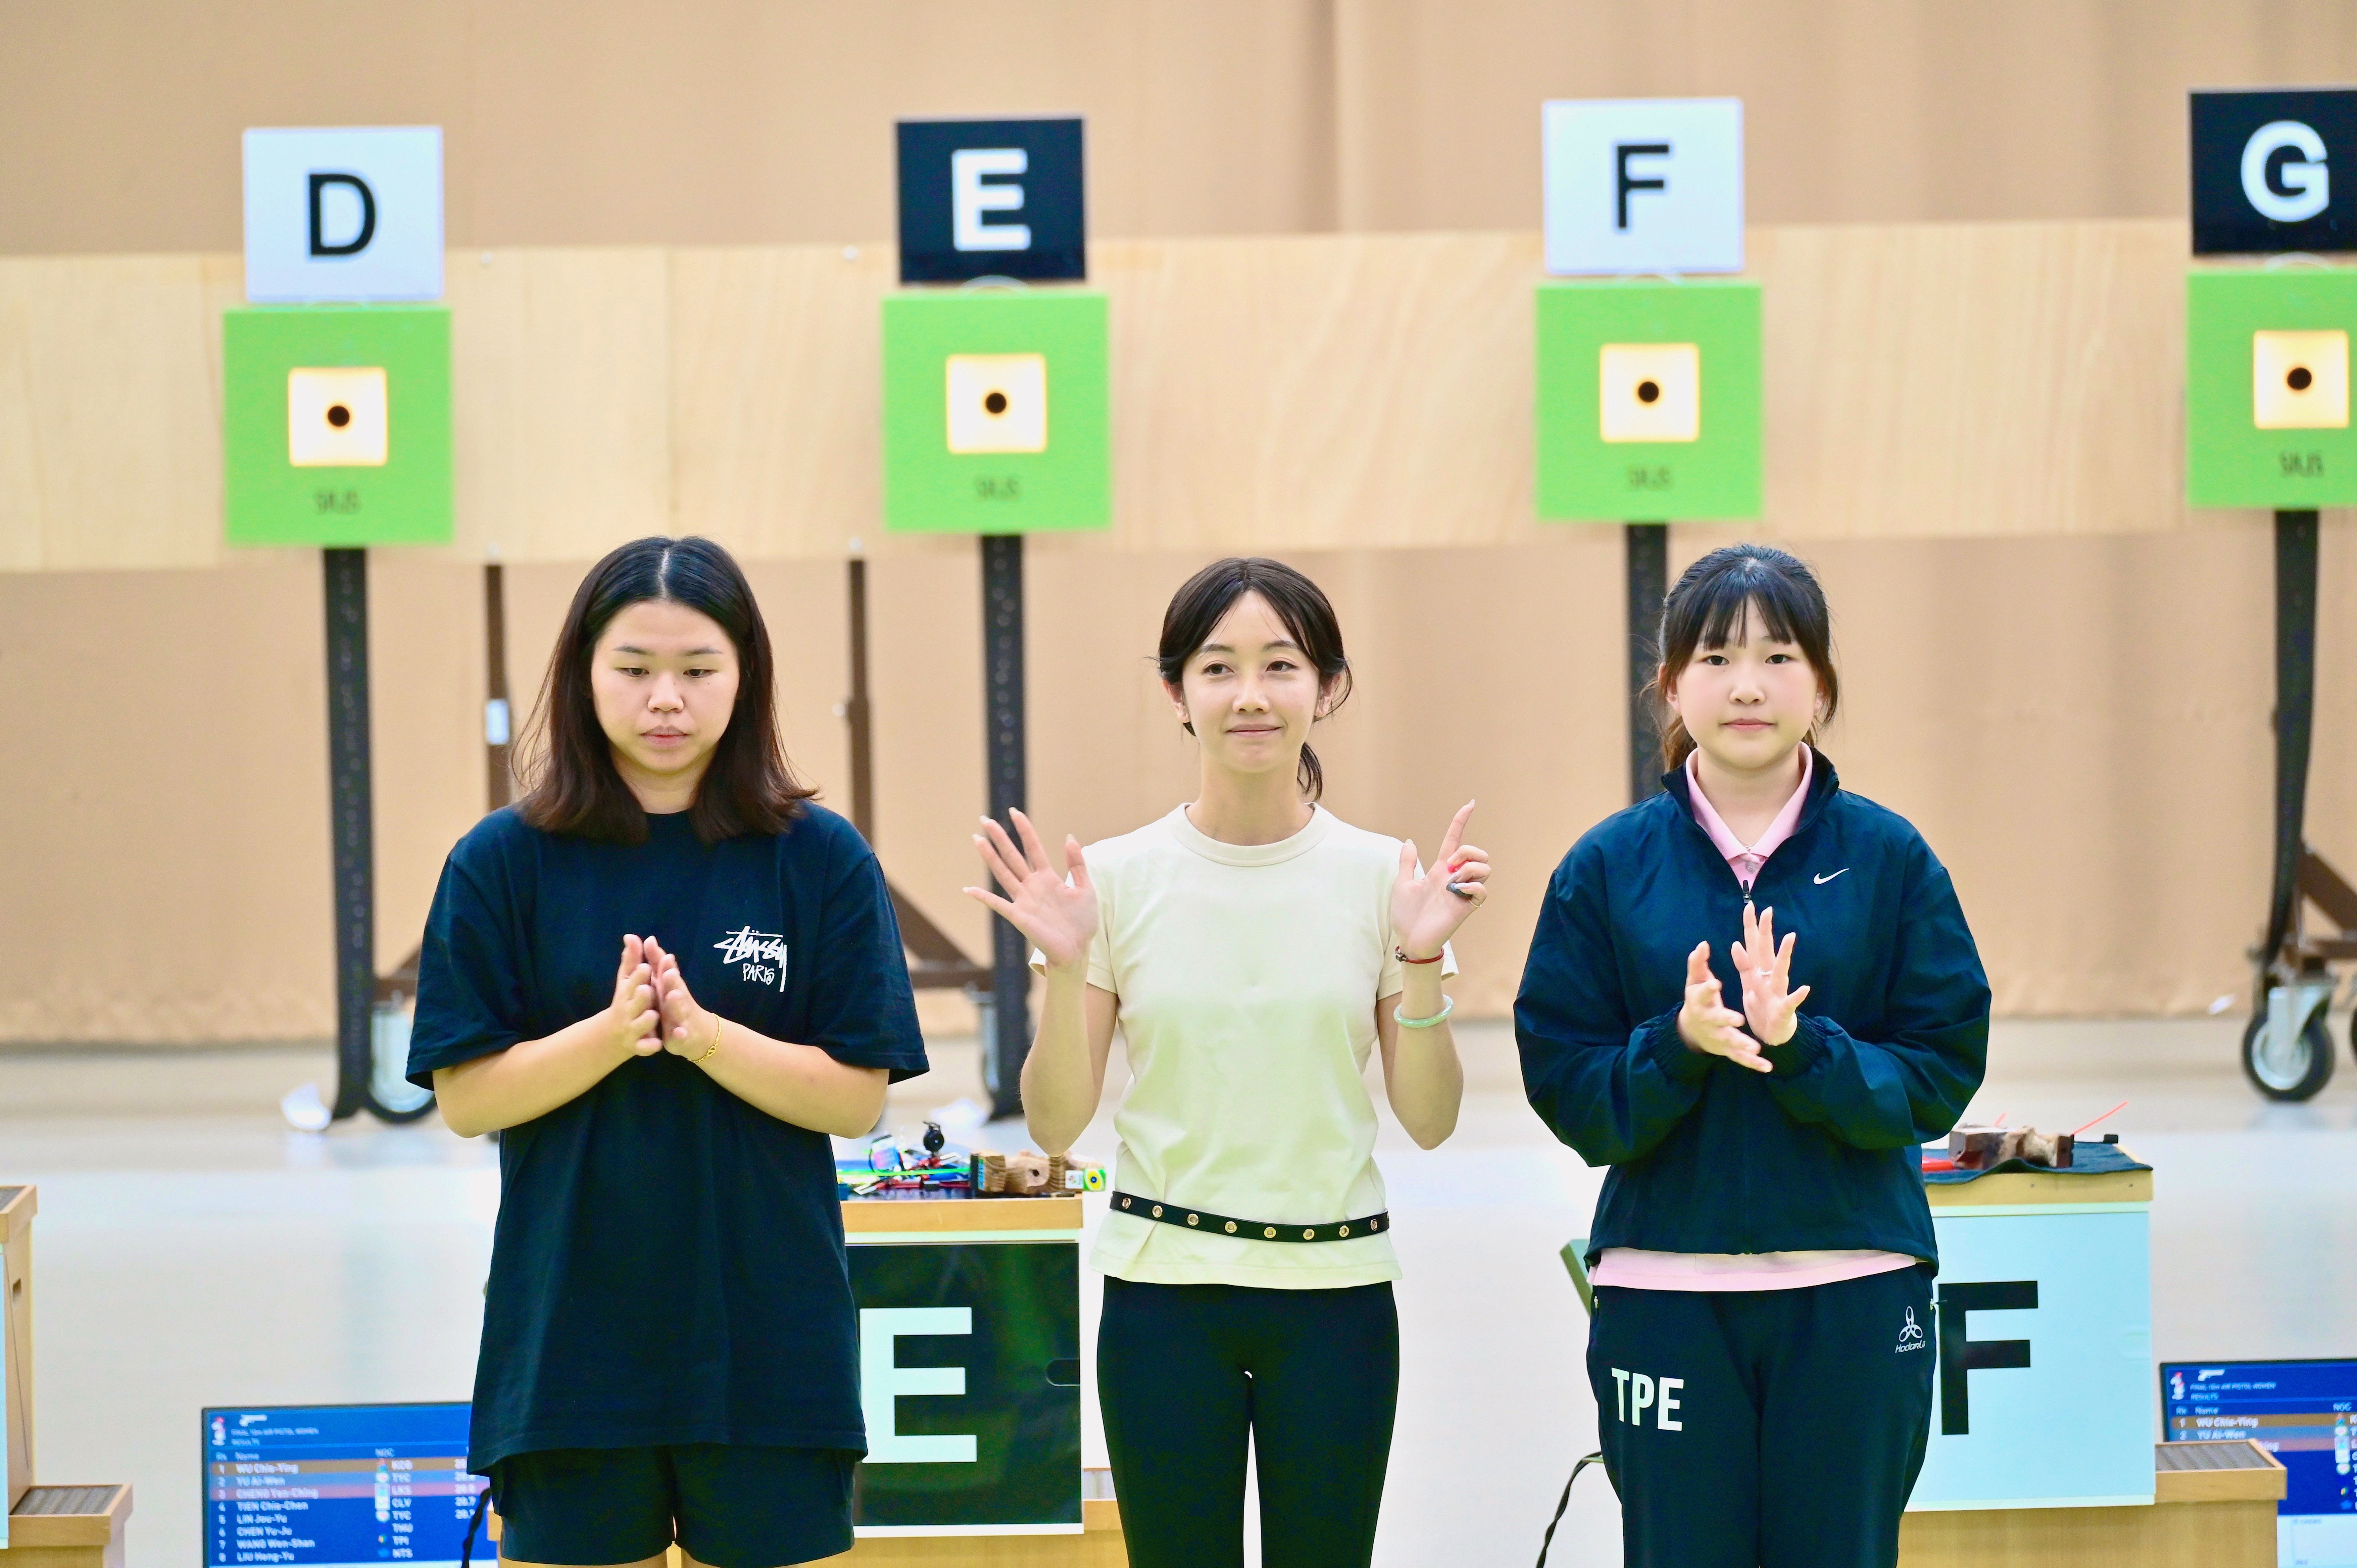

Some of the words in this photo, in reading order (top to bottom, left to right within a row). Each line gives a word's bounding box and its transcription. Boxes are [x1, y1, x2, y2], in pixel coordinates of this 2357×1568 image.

[951, 148, 1031, 252] E
[1616, 144, 1670, 229] F
[2240, 120, 2330, 223] G
[308, 173, 376, 256] D
[743, 963, 775, 985] PARIS
[860, 1307, 977, 1464] E
[1611, 1367, 1684, 1431] TPE
[1938, 1280, 2038, 1435] F
[2180, 1417, 2186, 1428] 1
[2180, 1430, 2187, 1440] 2
[2195, 1405, 2219, 1415] Name
